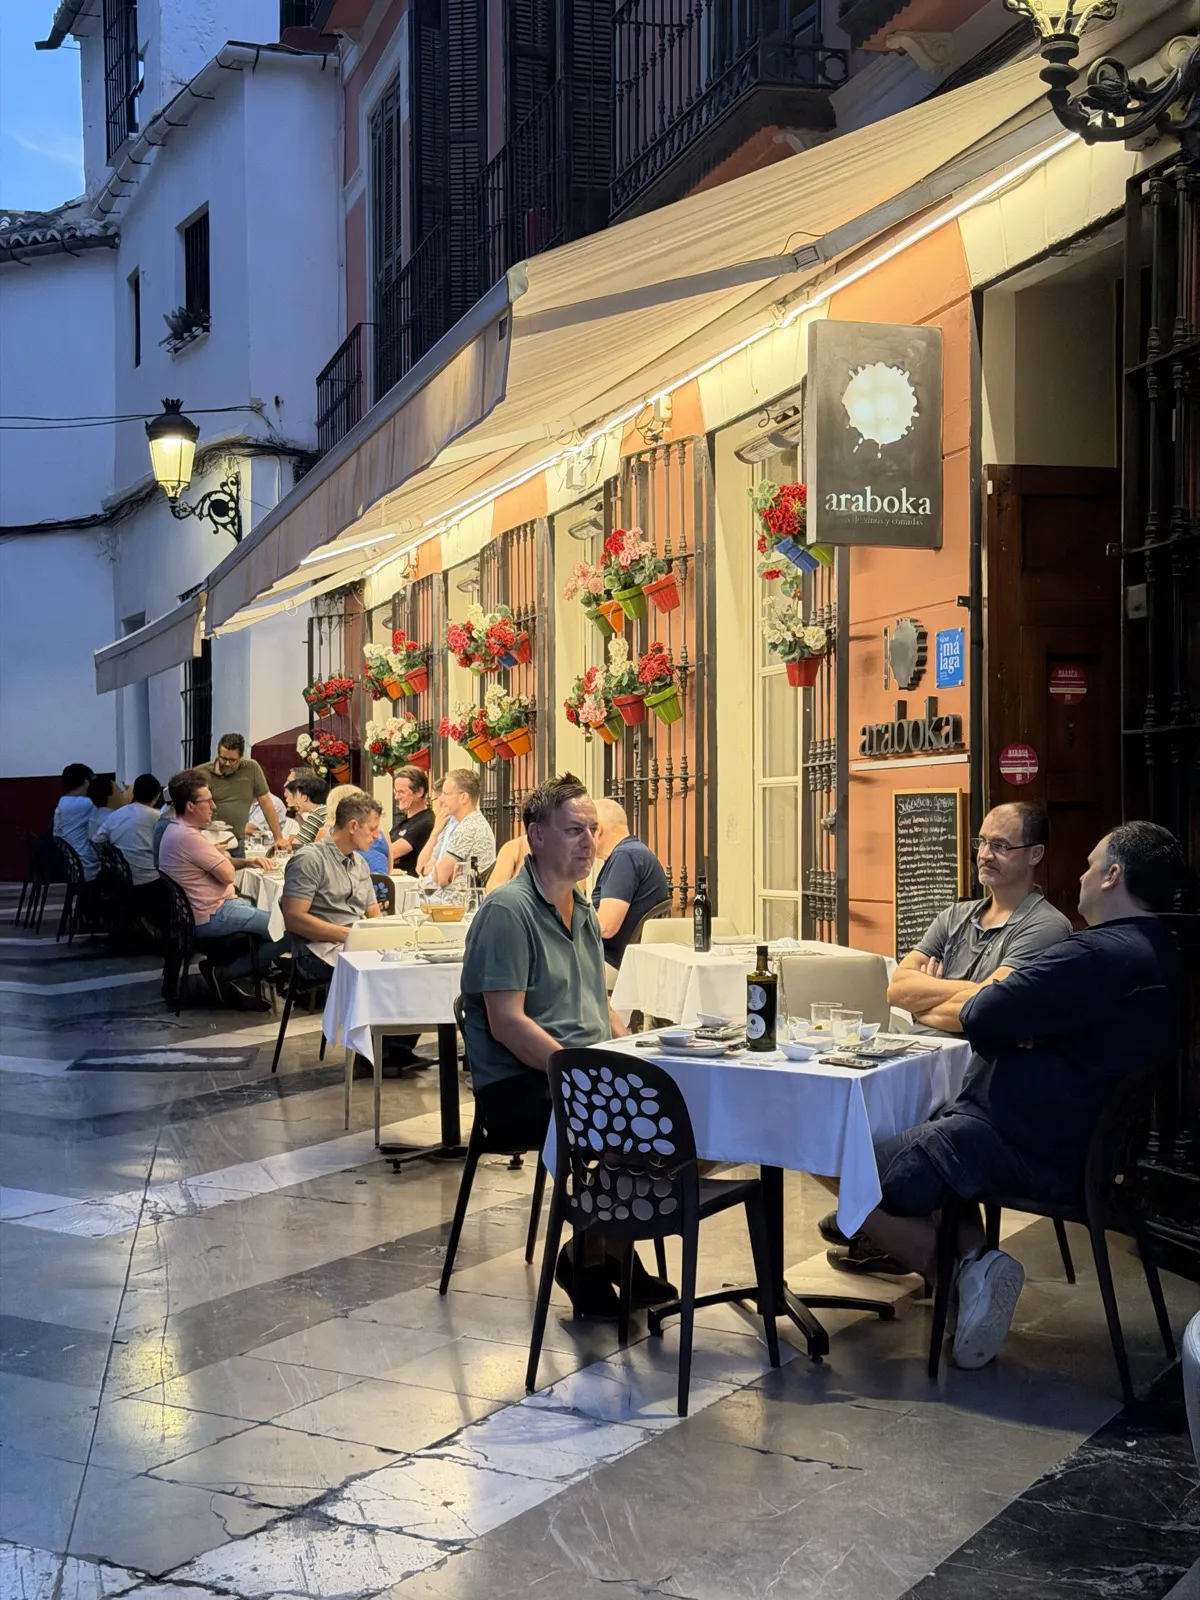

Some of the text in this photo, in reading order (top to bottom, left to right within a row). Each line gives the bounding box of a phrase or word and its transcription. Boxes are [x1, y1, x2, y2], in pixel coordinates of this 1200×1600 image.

[825, 486, 932, 515] araboka
[943, 635, 960, 656] má
[940, 653, 960, 674] laga
[859, 696, 965, 757] araboka
